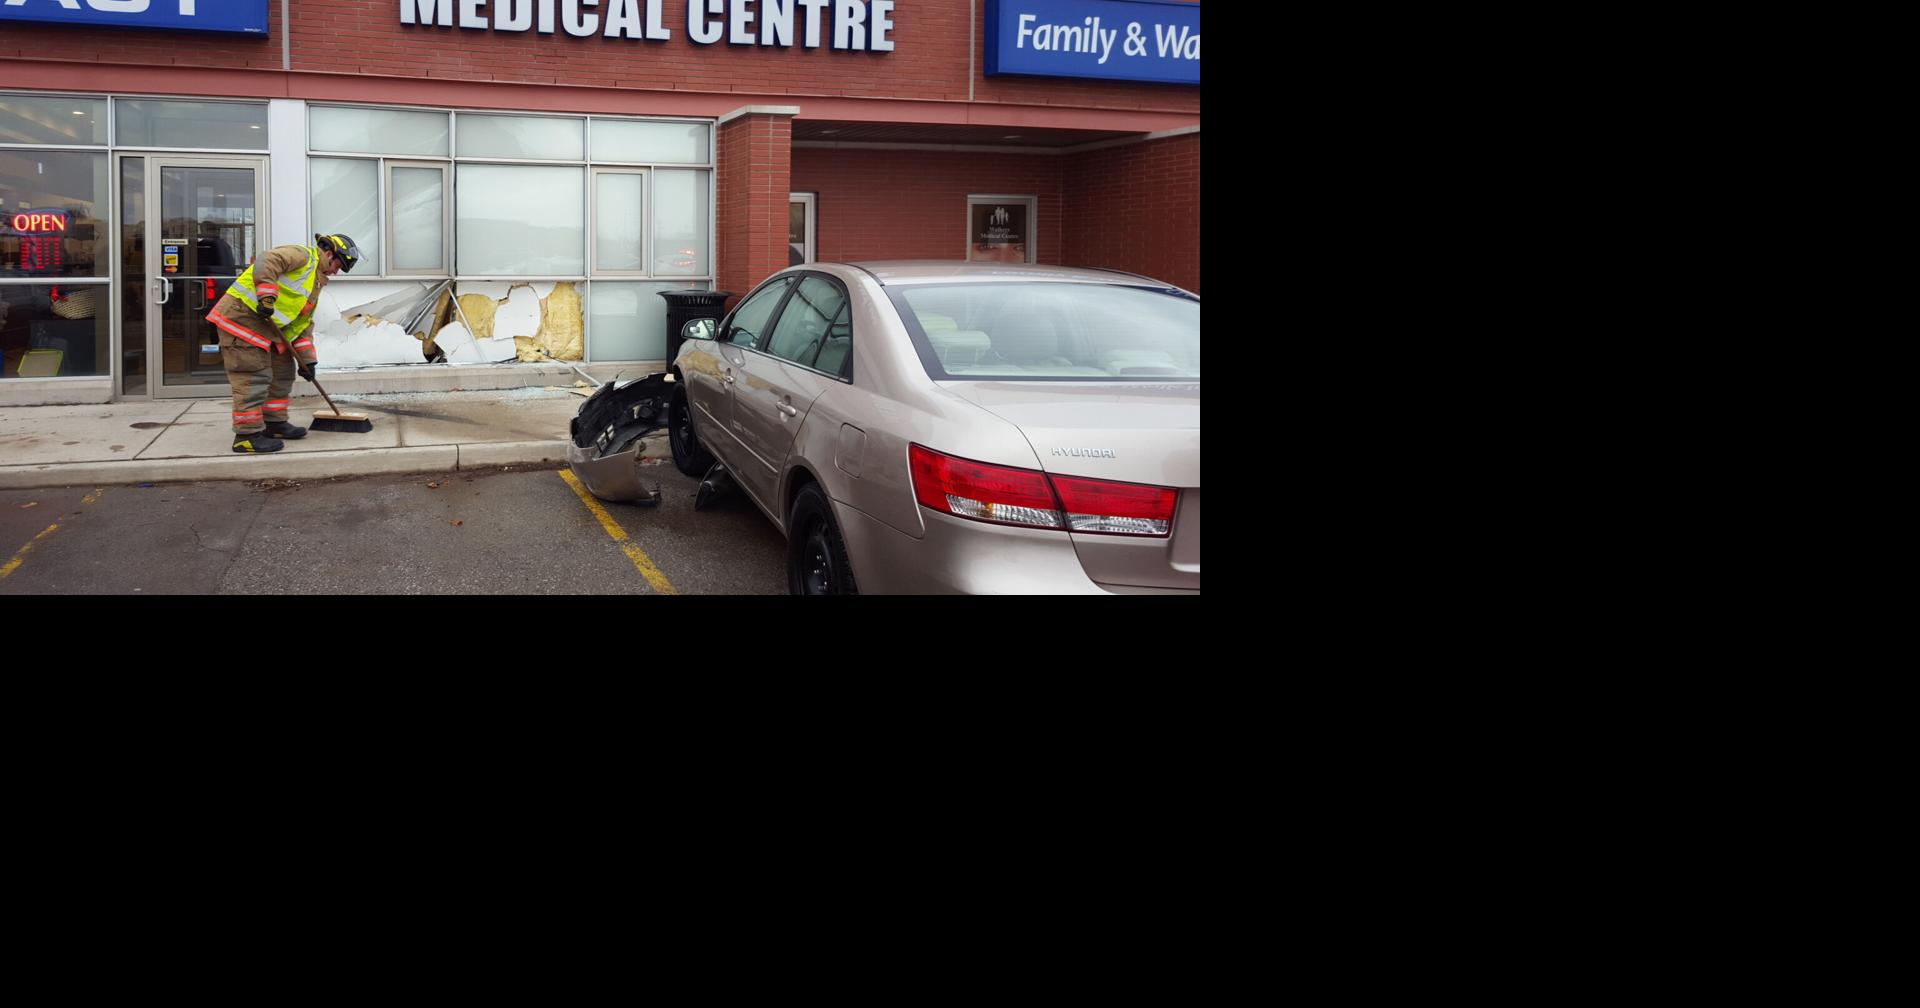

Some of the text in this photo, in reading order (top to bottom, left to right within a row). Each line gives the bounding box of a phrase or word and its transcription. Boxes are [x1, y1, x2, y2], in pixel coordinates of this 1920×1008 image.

[400, 0, 895, 51] MEDICAL CENTRE
[1016, 13, 1200, 65] Family & Wa
[14, 214, 65, 231] OPEN
[1051, 447, 1116, 458] HYUNDAI
